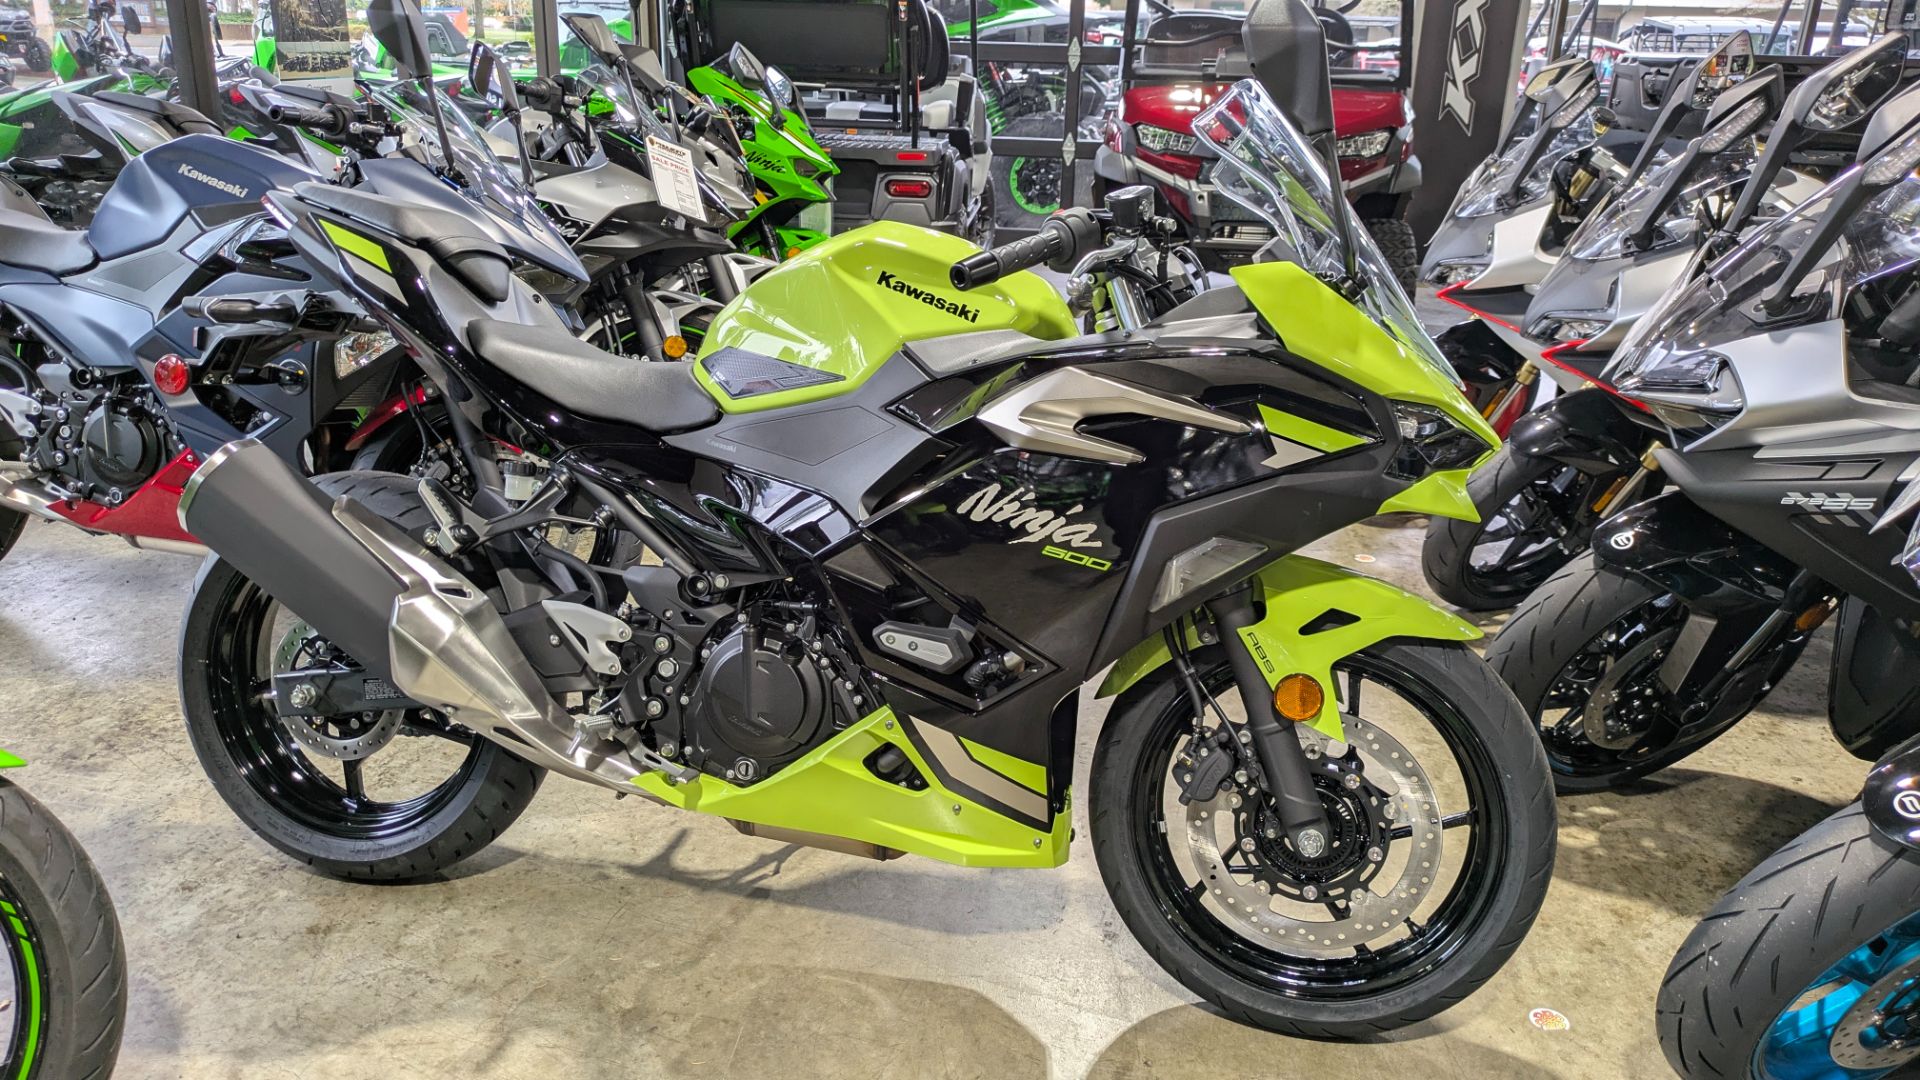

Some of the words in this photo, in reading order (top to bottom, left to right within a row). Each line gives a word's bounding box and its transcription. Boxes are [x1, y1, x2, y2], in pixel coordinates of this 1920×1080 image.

[650, 154, 669, 166] SALE
[670, 162, 689, 174] PRICE
[744, 150, 787, 174] Ninja
[177, 163, 249, 198] Kawasaki
[876, 270, 981, 323] Kawasaki
[956, 483, 1102, 547] Ninja
[1041, 545, 1113, 571] 500
[1246, 631, 1276, 674] ABS
